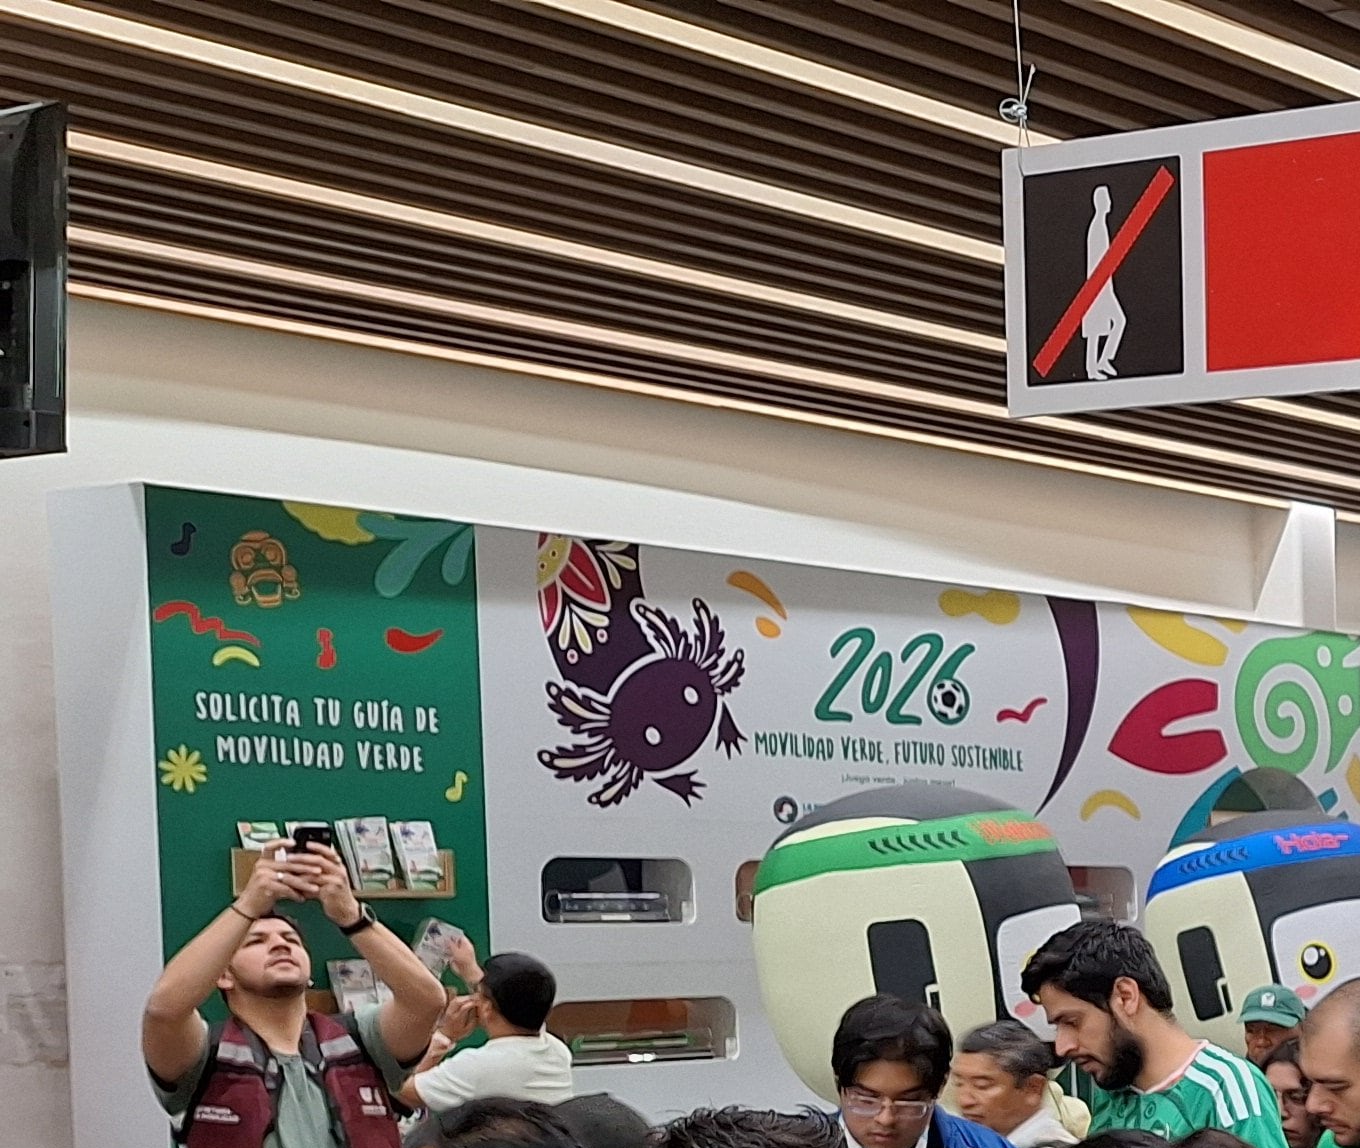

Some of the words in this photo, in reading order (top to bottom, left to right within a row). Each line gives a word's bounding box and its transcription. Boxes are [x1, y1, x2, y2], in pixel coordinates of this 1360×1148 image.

[814, 626, 976, 726] 2026
[194, 691, 301, 728] SOLICITA
[313, 696, 341, 727] TU
[353, 699, 404, 734] GUÍA
[415, 706, 440, 734] DE
[215, 735, 344, 770] MOVILIDAD
[356, 741, 424, 773] VERDE
[754, 731, 834, 761] MOVILIDAD
[841, 735, 889, 766] VERDE,
[894, 740, 945, 767] FUTURO
[951, 744, 1023, 772] SOSTENIBLE
